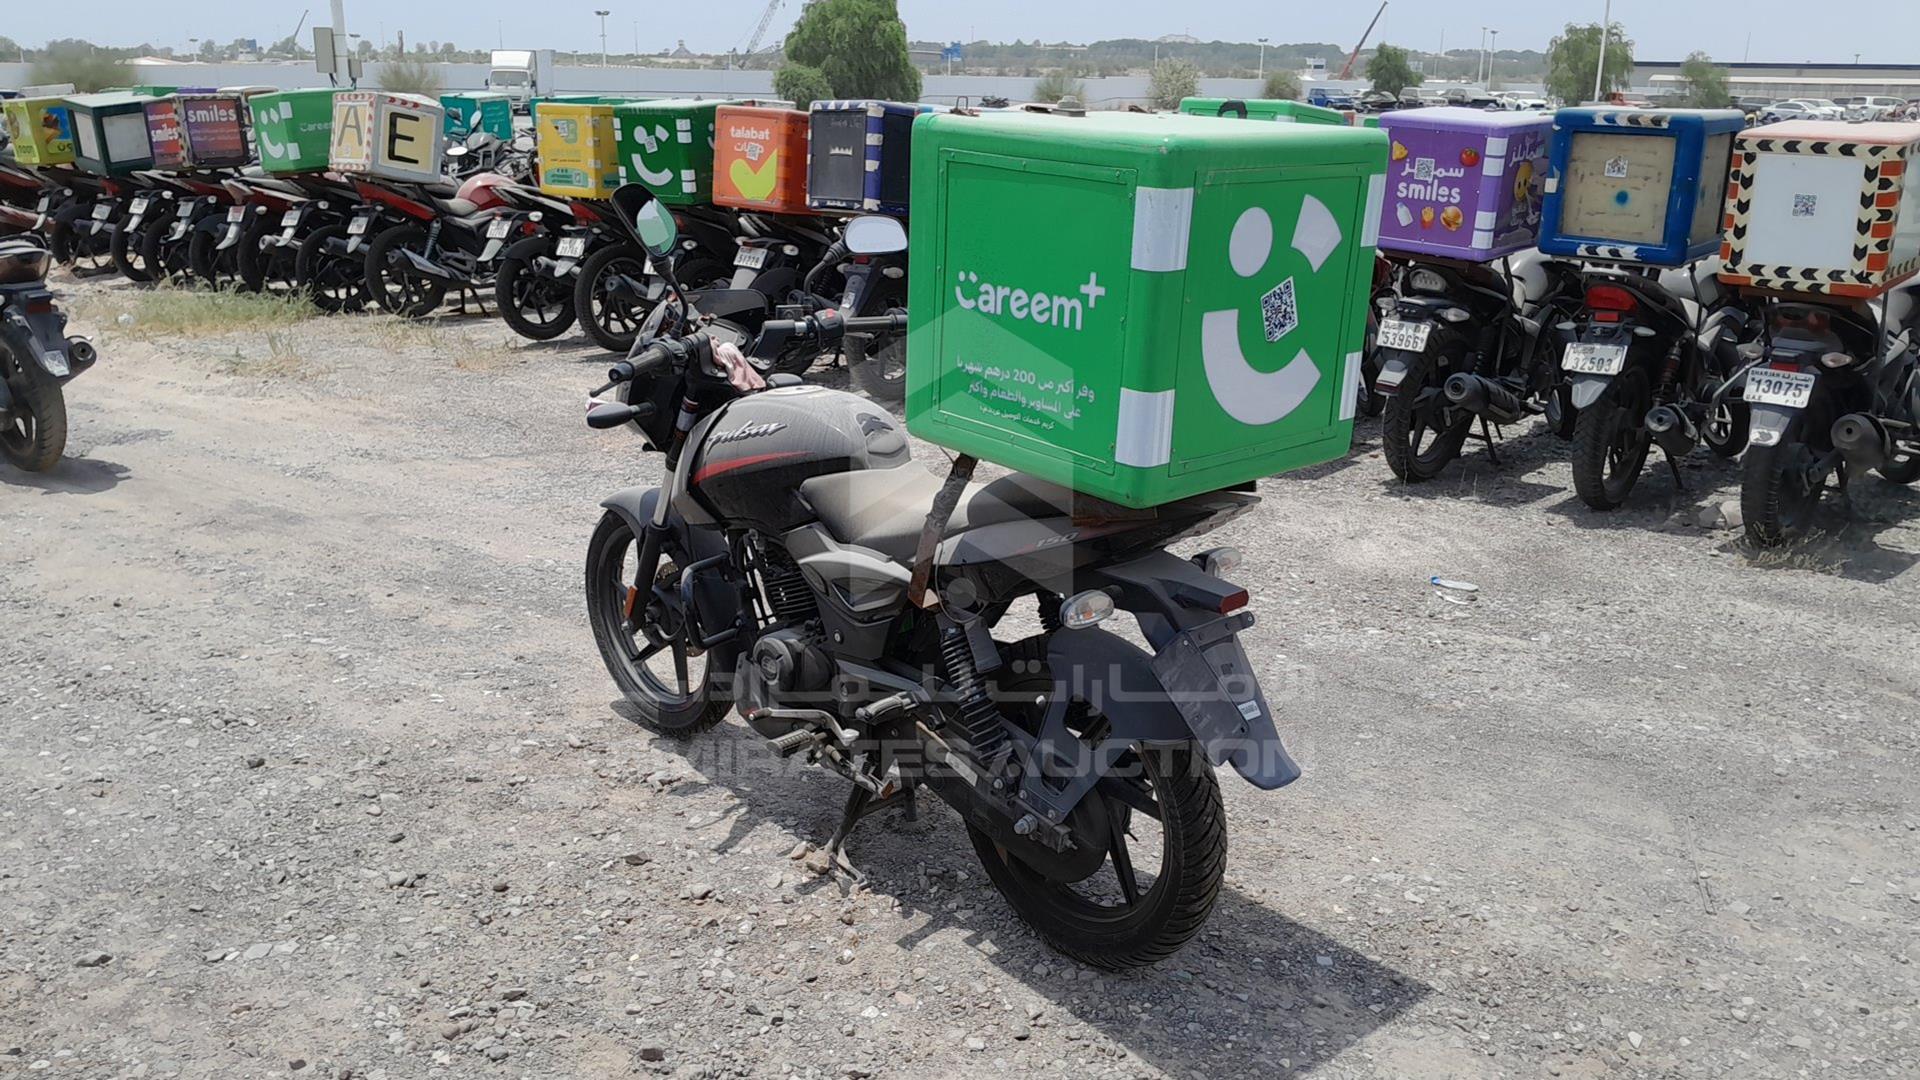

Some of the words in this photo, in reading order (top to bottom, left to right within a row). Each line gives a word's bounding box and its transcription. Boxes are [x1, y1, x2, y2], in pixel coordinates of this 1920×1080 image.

[188, 104, 236, 122] smiles
[338, 105, 363, 147] A
[730, 126, 770, 140] talabat
[387, 111, 420, 164] E
[1397, 179, 1461, 204] smiles
[1382, 331, 1420, 349] 53966
[1572, 357, 1613, 372] 32503
[1013, 369, 1036, 385] 200
[1755, 379, 1805, 398] 13075
